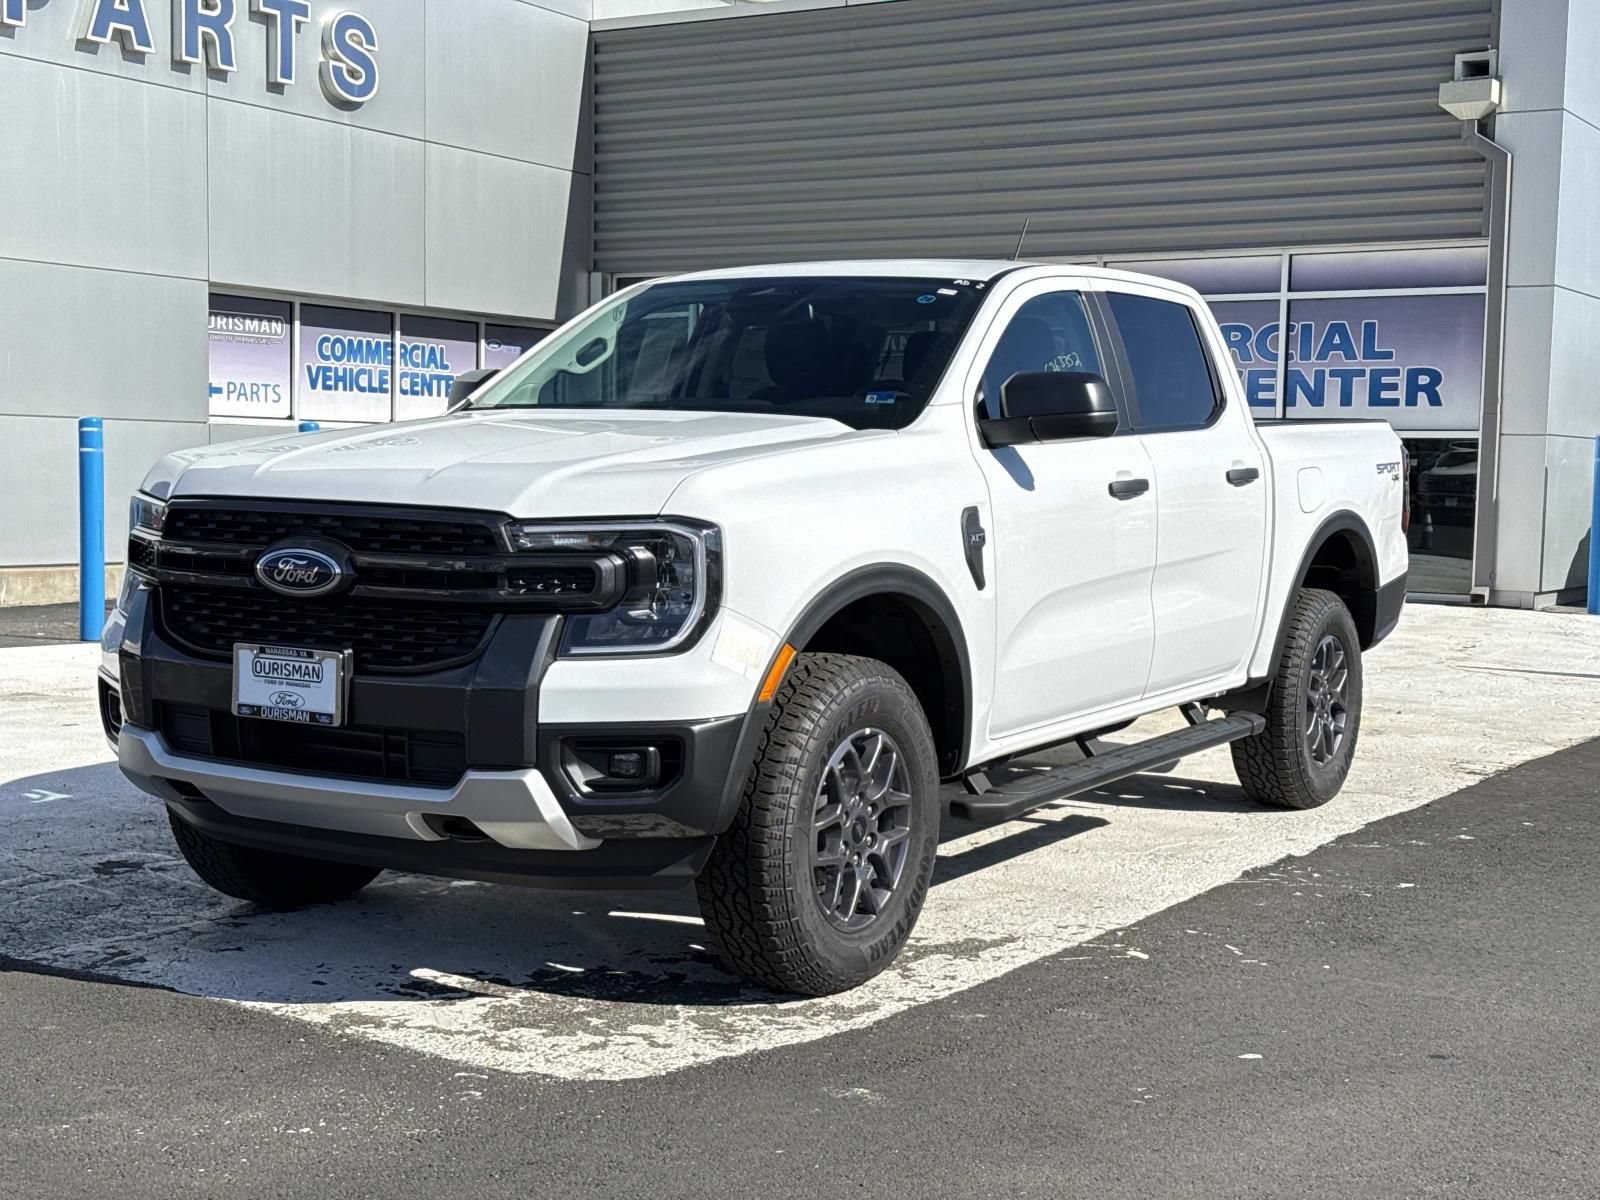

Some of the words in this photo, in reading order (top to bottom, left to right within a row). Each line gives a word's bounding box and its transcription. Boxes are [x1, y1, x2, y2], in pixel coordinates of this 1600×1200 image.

[208, 314, 282, 335] URISMAN
[1219, 320, 1394, 362] RCIAL
[317, 335, 450, 370] COMMERCIAL
[226, 381, 281, 403] PARTS
[306, 364, 390, 394] VEHICLE
[400, 371, 455, 398] CENTE
[1243, 367, 1444, 408] ENTER
[1375, 461, 1400, 474] SPORT
[274, 557, 319, 584] Ford
[254, 660, 320, 680] OURISMAN
[275, 693, 299, 707] Ford
[260, 706, 310, 722] OURISMAN
